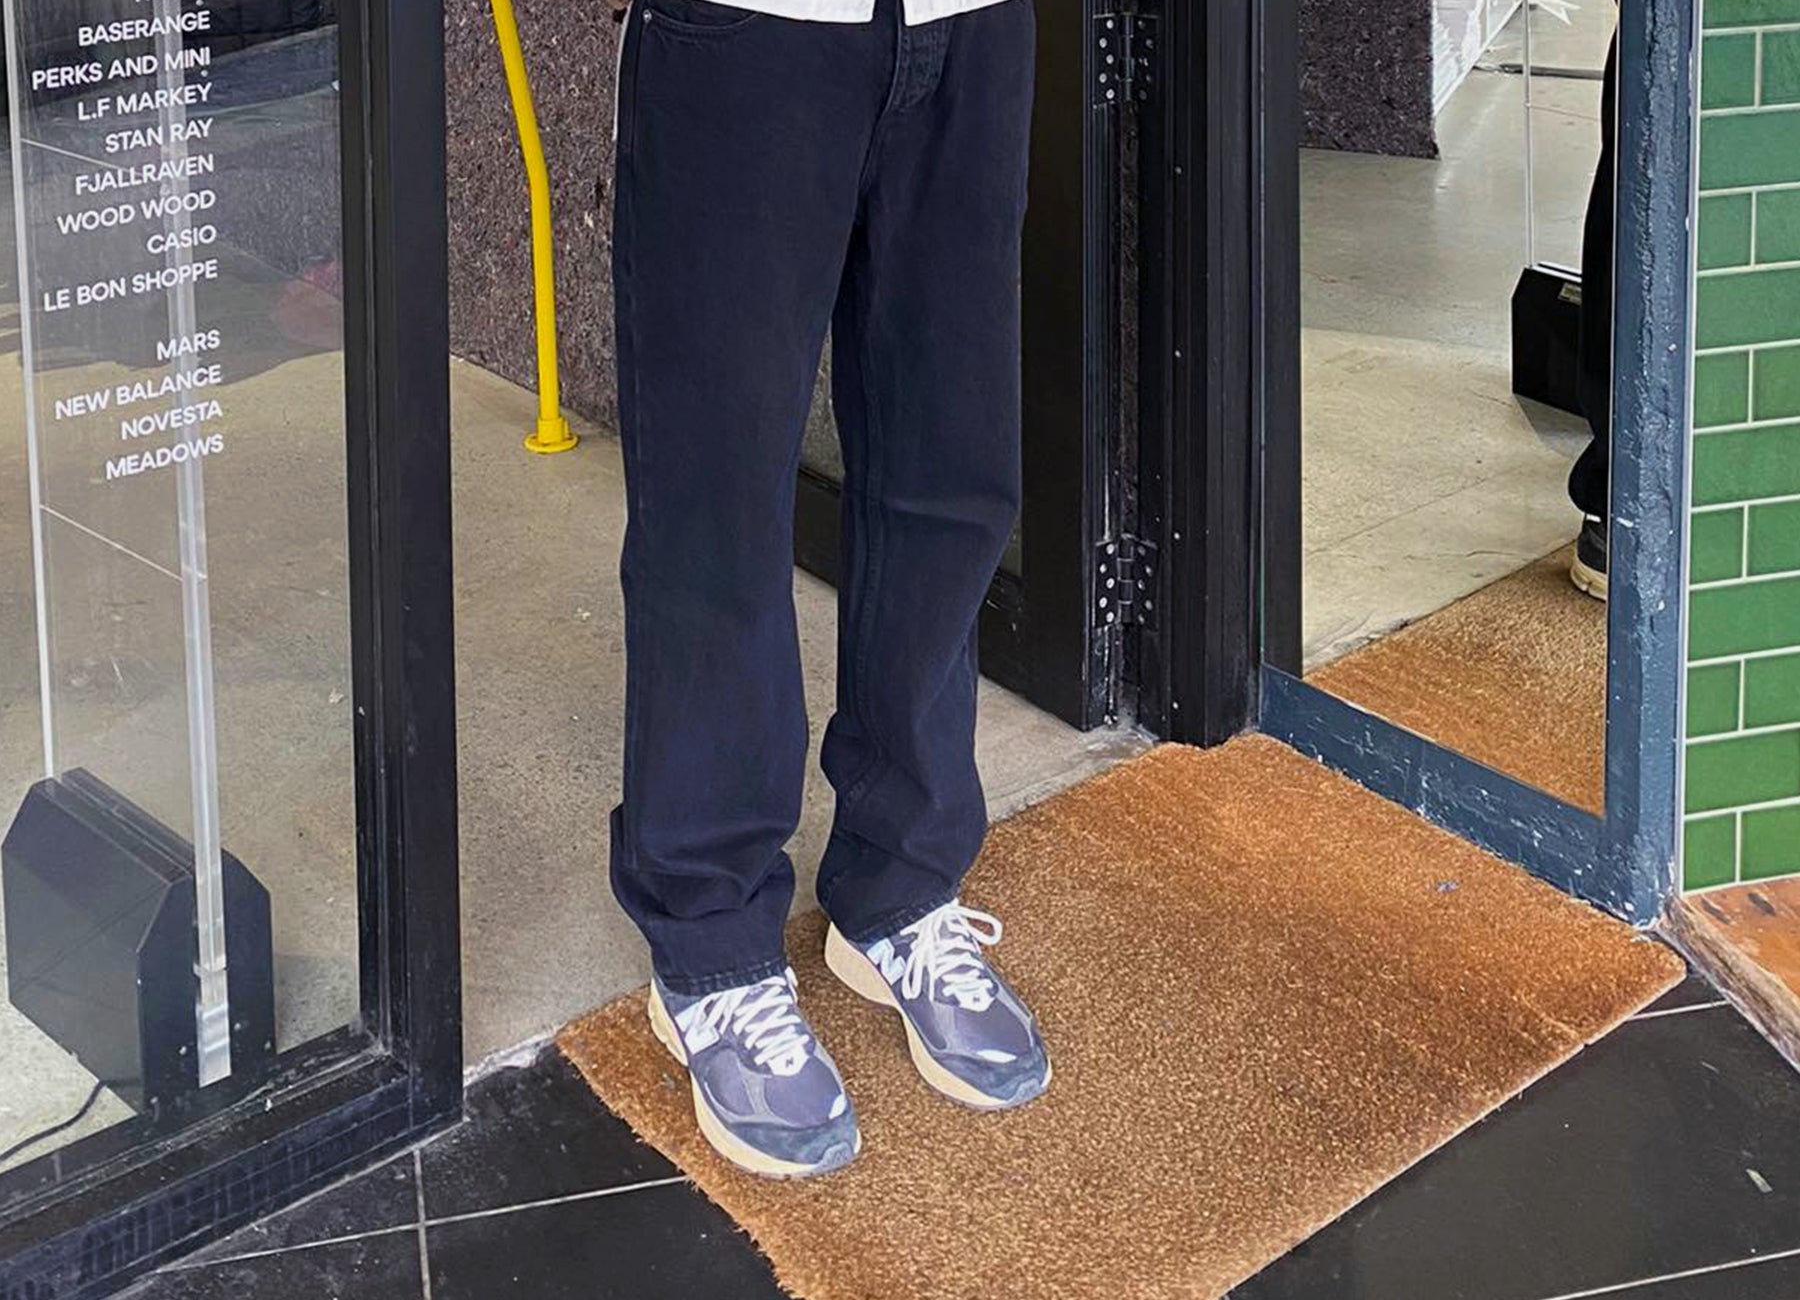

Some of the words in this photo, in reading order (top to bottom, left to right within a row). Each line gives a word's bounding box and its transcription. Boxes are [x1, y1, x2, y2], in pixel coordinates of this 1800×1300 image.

[78, 10, 211, 47] BASERANGE
[32, 62, 103, 90] PERKS
[108, 55, 159, 80] AND
[164, 46, 211, 71] MINI
[77, 97, 111, 121] L.F
[116, 82, 212, 115] MARKEY
[105, 126, 163, 153] STAN
[170, 118, 214, 143] RAY
[75, 153, 214, 195] FJALLRAVEN
[56, 204, 136, 235] WOOD
[140, 189, 216, 220] WOOD
[146, 224, 217, 254] CASIO
[44, 288, 71, 312] LE
[76, 277, 126, 305] BON
[132, 259, 218, 294] SHOPPE
[156, 329, 221, 361] MARS
[55, 388, 110, 420] NEW
[116, 364, 222, 405] BALANCE
[121, 399, 224, 440] NOVESTA
[105, 434, 224, 480] MEADOWS
